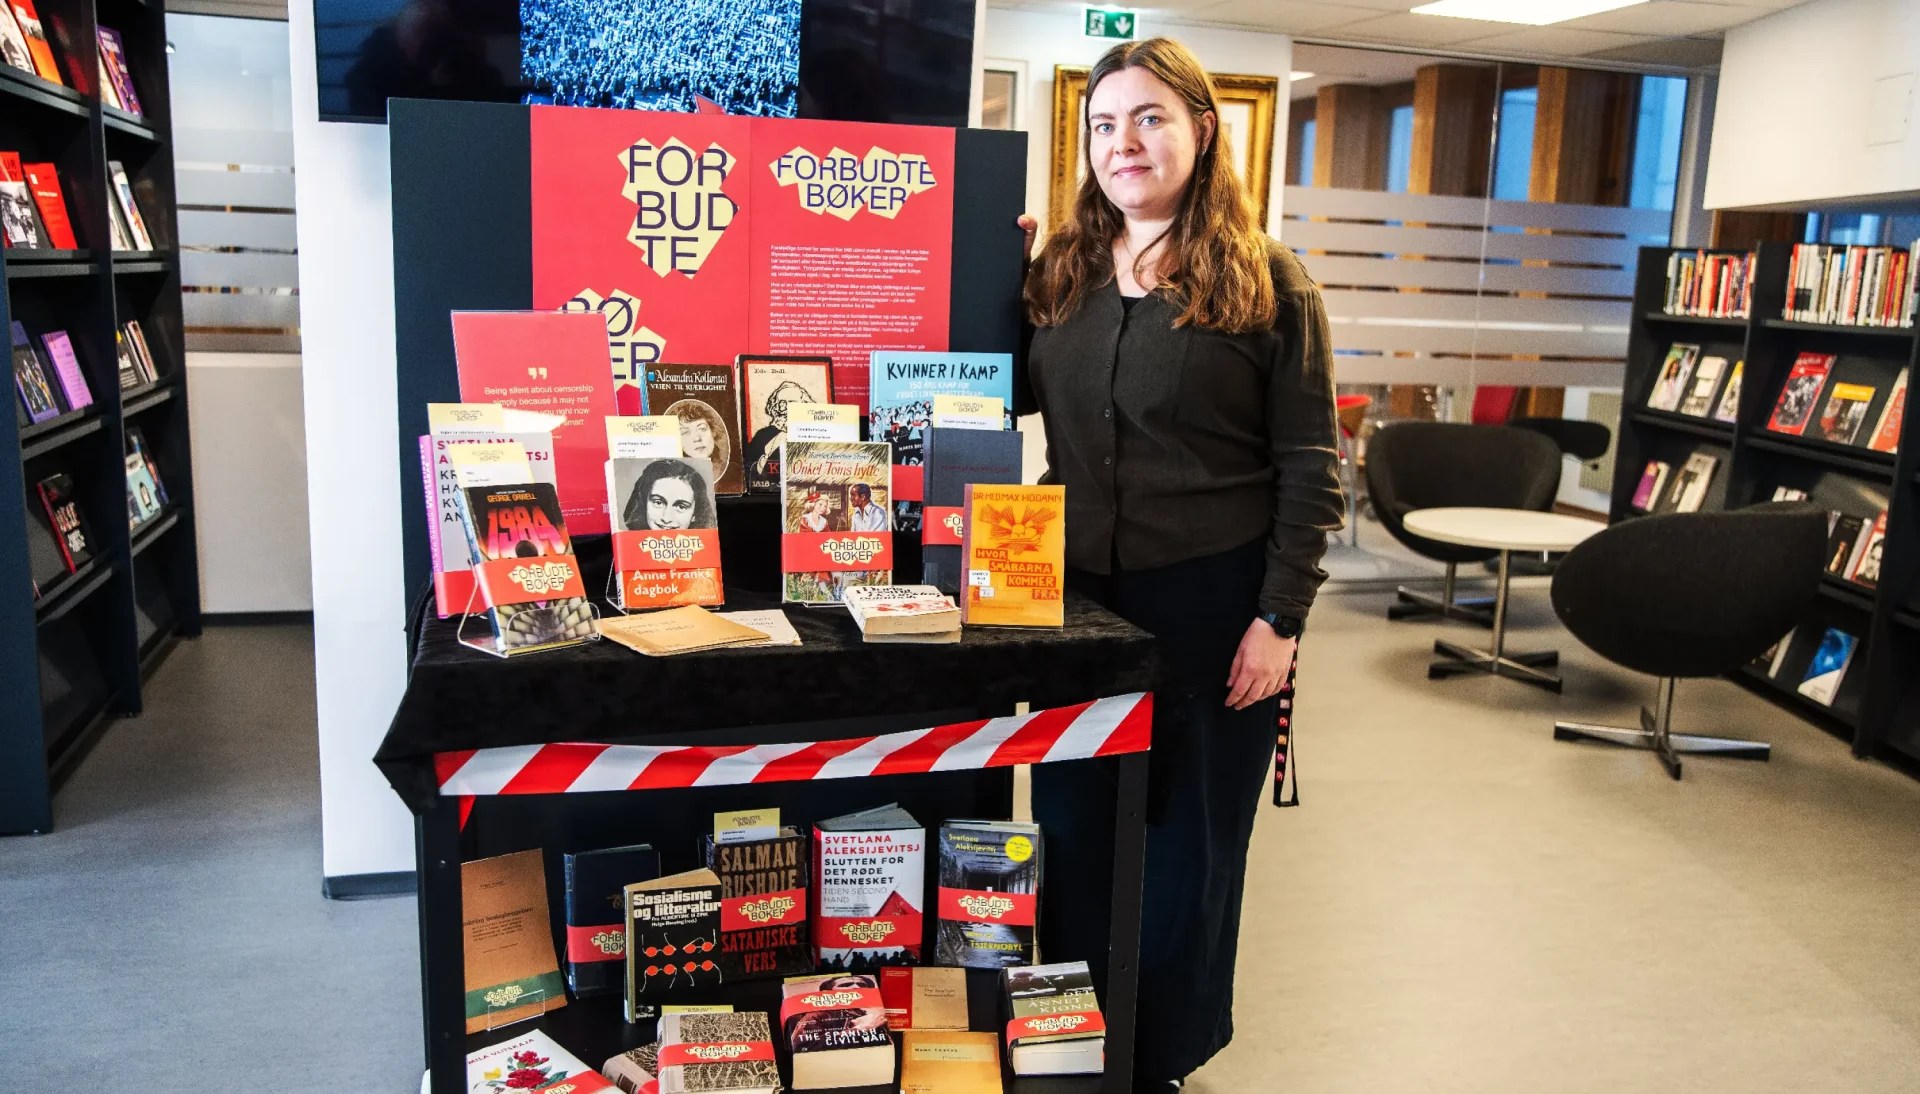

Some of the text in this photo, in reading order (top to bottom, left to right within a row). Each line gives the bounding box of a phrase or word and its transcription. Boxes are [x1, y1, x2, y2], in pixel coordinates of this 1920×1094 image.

[629, 144, 728, 186] FOR
[777, 155, 936, 185] FORBUDTE
[806, 183, 906, 211] BØKER
[636, 190, 738, 231] BUD
[635, 235, 699, 275] TE
[609, 341, 660, 380] ER
[655, 369, 693, 383] Alexandra
[887, 362, 946, 380] KVINNER
[951, 363, 954, 379] I
[959, 362, 999, 380] KAMP
[484, 384, 594, 396] Being silent about censorship
[519, 397, 551, 405] because
[559, 397, 575, 405] may
[793, 459, 822, 475] Onkel
[825, 460, 852, 475] Toms
[853, 462, 880, 479] hytte
[487, 494, 512, 503] GEORGE
[1001, 493, 1019, 501] MAX
[487, 506, 567, 559] 1984
[641, 538, 703, 549] FORBUDTE
[822, 541, 883, 552] FORBUDTE
[834, 551, 874, 561] BØKER
[977, 550, 1006, 558] HVOR
[511, 565, 574, 579] FORBUDTE
[633, 569, 713, 580] Anne Franks
[1008, 576, 1054, 587] KOMMER
[634, 584, 679, 598] dagbok
[825, 835, 892, 844] SVETLANA
[949, 834, 978, 842] Svetlana
[825, 844, 920, 855] ALEKSIJEVITSJ
[721, 841, 798, 873] SALMAN
[825, 858, 877, 866] SLUTTEN
[824, 868, 883, 876] DET RØDE
[721, 870, 798, 899] RUSHDIE
[824, 877, 895, 885] MENNESKET
[823, 887, 849, 895] TIDEN
[633, 890, 713, 906] Sosialisme
[960, 897, 1014, 909] FORBUDTE
[633, 900, 722, 920] og litteratur
[740, 896, 796, 913] FORBUDTE
[751, 908, 786, 921] BØKER
[842, 923, 895, 933] FORBUDTE
[593, 933, 626, 944] FORB
[721, 927, 798, 951] SATANISKE
[852, 931, 886, 941] BØKER
[603, 941, 626, 951] BØK
[971, 941, 1023, 951] TSJERNOBYL
[744, 951, 777, 974] VERS
[1028, 997, 1082, 1008] ANNET
[799, 1027, 877, 1042] THE SPANISH
[826, 1034, 886, 1046] CIVIL WAR
[468, 1054, 489, 1065] MILA
